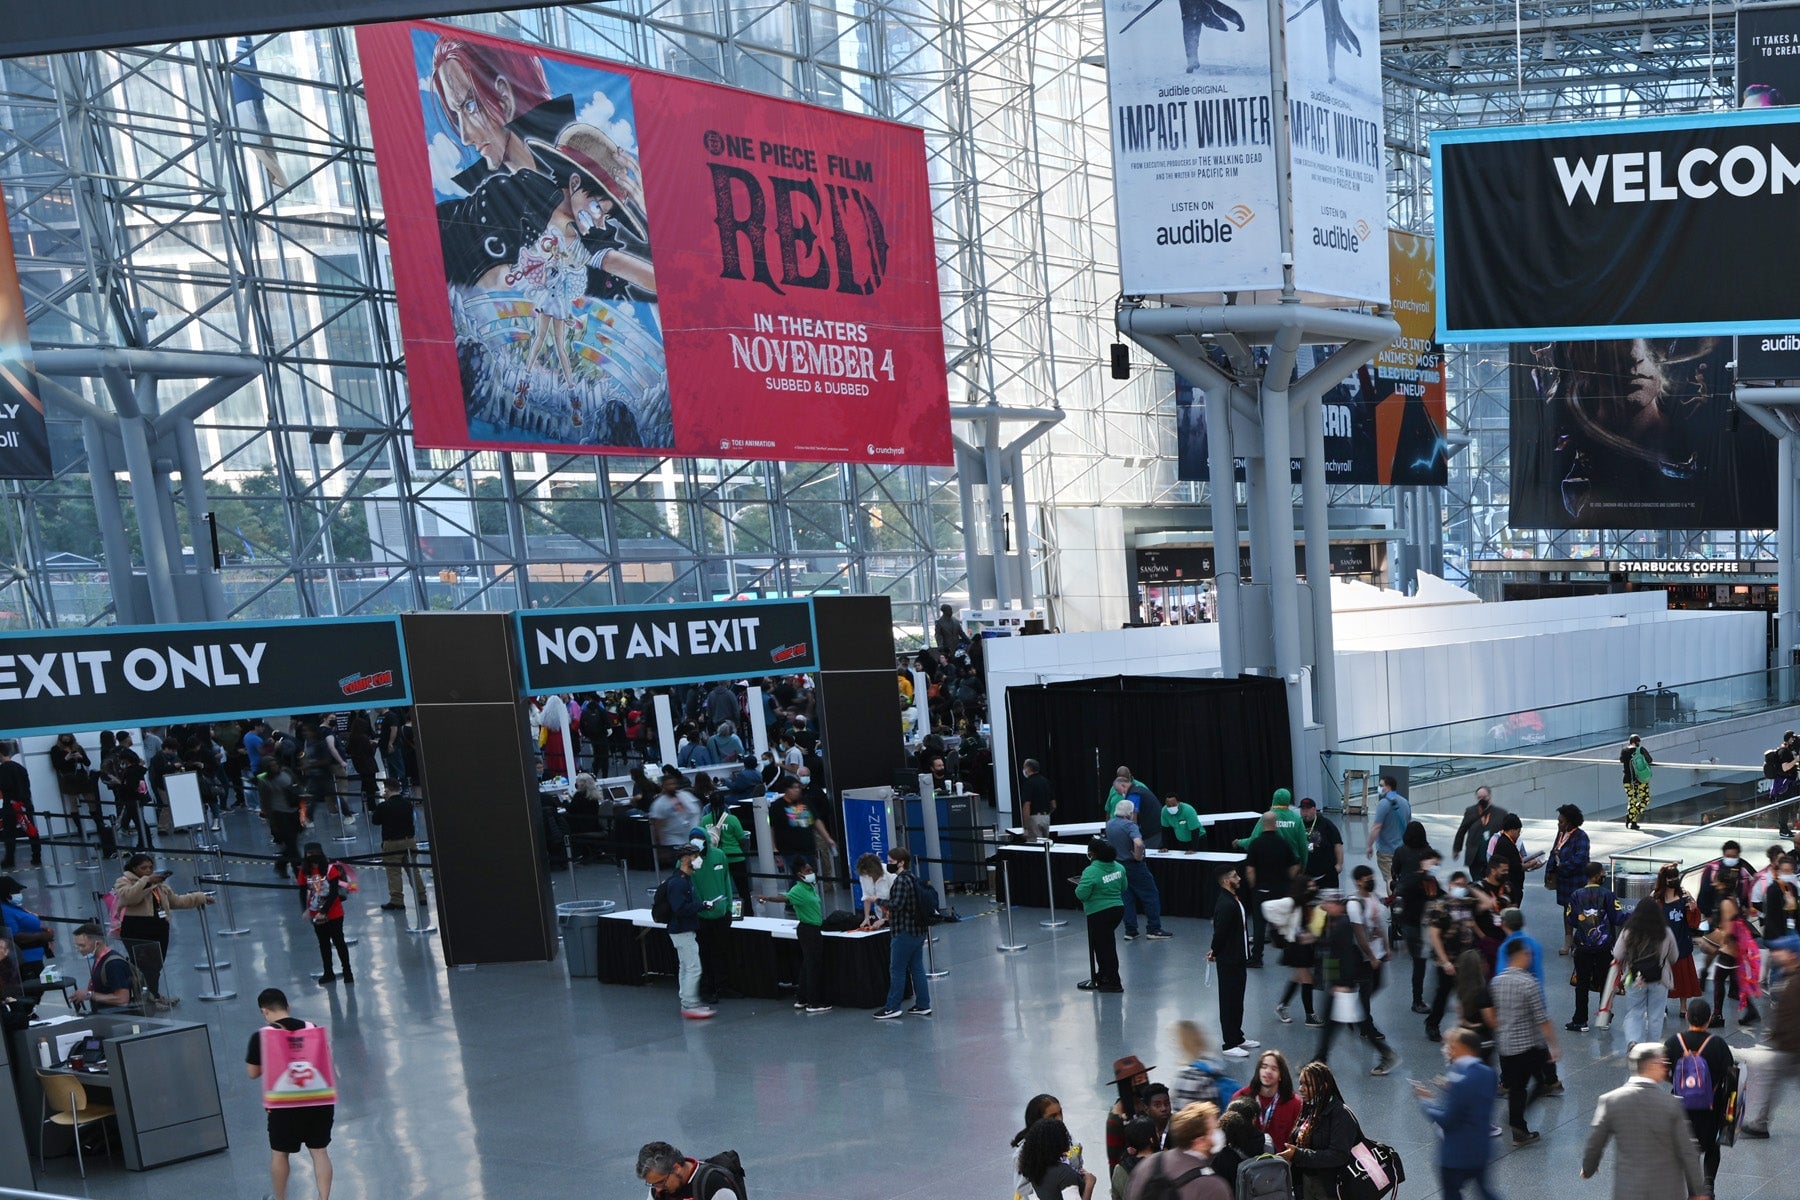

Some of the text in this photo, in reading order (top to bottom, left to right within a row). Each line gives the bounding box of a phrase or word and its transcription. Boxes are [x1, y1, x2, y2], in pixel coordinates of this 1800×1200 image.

[1752, 36, 1760, 46] IT
[1764, 34, 1790, 44] TAKES
[1793, 34, 1798, 42] A
[1762, 48, 1772, 56] TO
[1158, 84, 1228, 98] audible ORIGINAL
[1119, 96, 1272, 153] IMPACT WINTER
[1290, 98, 1379, 172] MPACT WINTER
[703, 130, 874, 183] ONE PIECE FILM
[1198, 156, 1211, 165] THE
[1214, 154, 1244, 164] WALKING
[1246, 153, 1262, 163] DEAD
[1198, 168, 1223, 178] PACIFIC
[1225, 167, 1238, 176] RIM
[1172, 201, 1214, 212] LISTEN ON
[1320, 206, 1347, 219] LISTEN ON
[706, 162, 890, 296] RED
[1156, 218, 1232, 246] audible
[1313, 225, 1358, 253] audible
[1393, 299, 1430, 314] crunchyroll
[754, 313, 868, 342] IN THEATERS
[1411, 340, 1431, 351] INTO
[728, 333, 896, 382] NOVEMBER 4
[1416, 355, 1439, 368] MOST
[1378, 366, 1440, 384] ELECTRIFYING
[766, 377, 869, 396] SUBBED & DUBBED
[1394, 383, 1426, 396] LINEUP
[875, 446, 905, 456] crunchyroll
[1619, 562, 1738, 572] STARBUCKS COFFEE
[535, 617, 760, 665] NOT AN EXIT
[0, 642, 267, 700] EXIT ONLY
[1102, 871, 1122, 884] SECURITY
